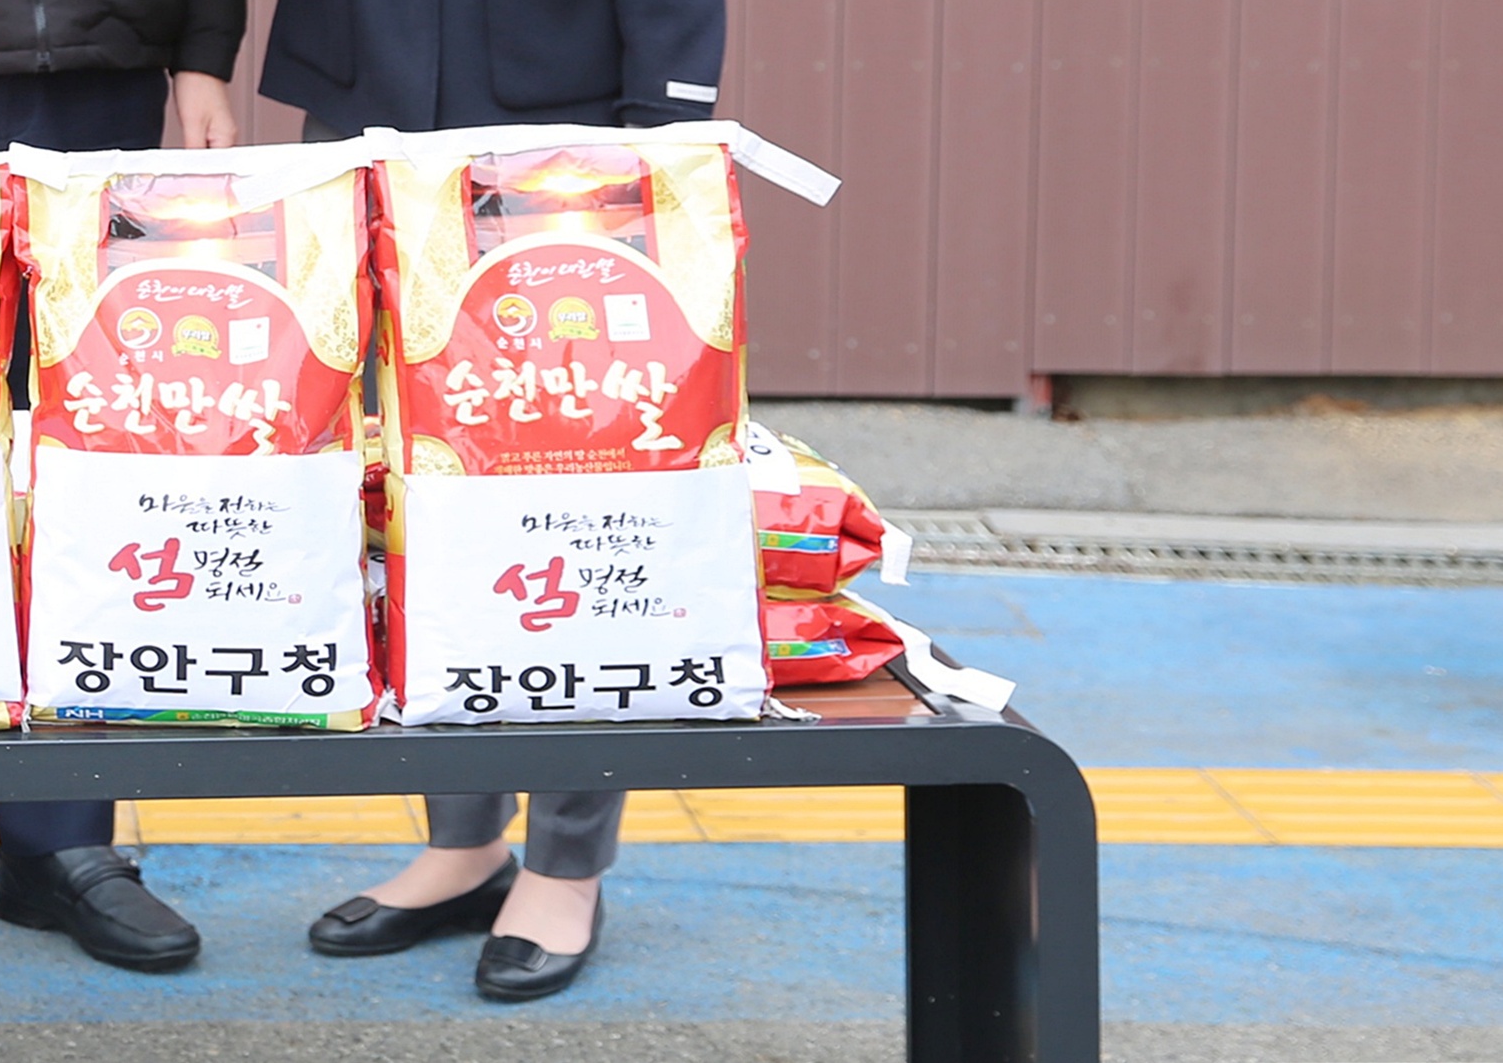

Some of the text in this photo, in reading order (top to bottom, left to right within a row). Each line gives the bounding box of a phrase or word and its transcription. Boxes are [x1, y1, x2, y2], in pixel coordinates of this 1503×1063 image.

[63, 370, 291, 456] 순천만쌀
[443, 357, 685, 451] 순천만쌀
[219, 495, 291, 514] 전하는
[186, 518, 274, 540] 따뜻한
[602, 512, 674, 532] 전하는
[569, 534, 657, 557] 따뜻한
[108, 537, 264, 612] 설 명절
[205, 582, 286, 603] 되세요
[493, 556, 649, 632] 설 명절
[591, 597, 671, 618] 되세요
[57, 640, 337, 698] 장안구청
[444, 657, 726, 713] 장안구청
[65, 707, 103, 719] NH
